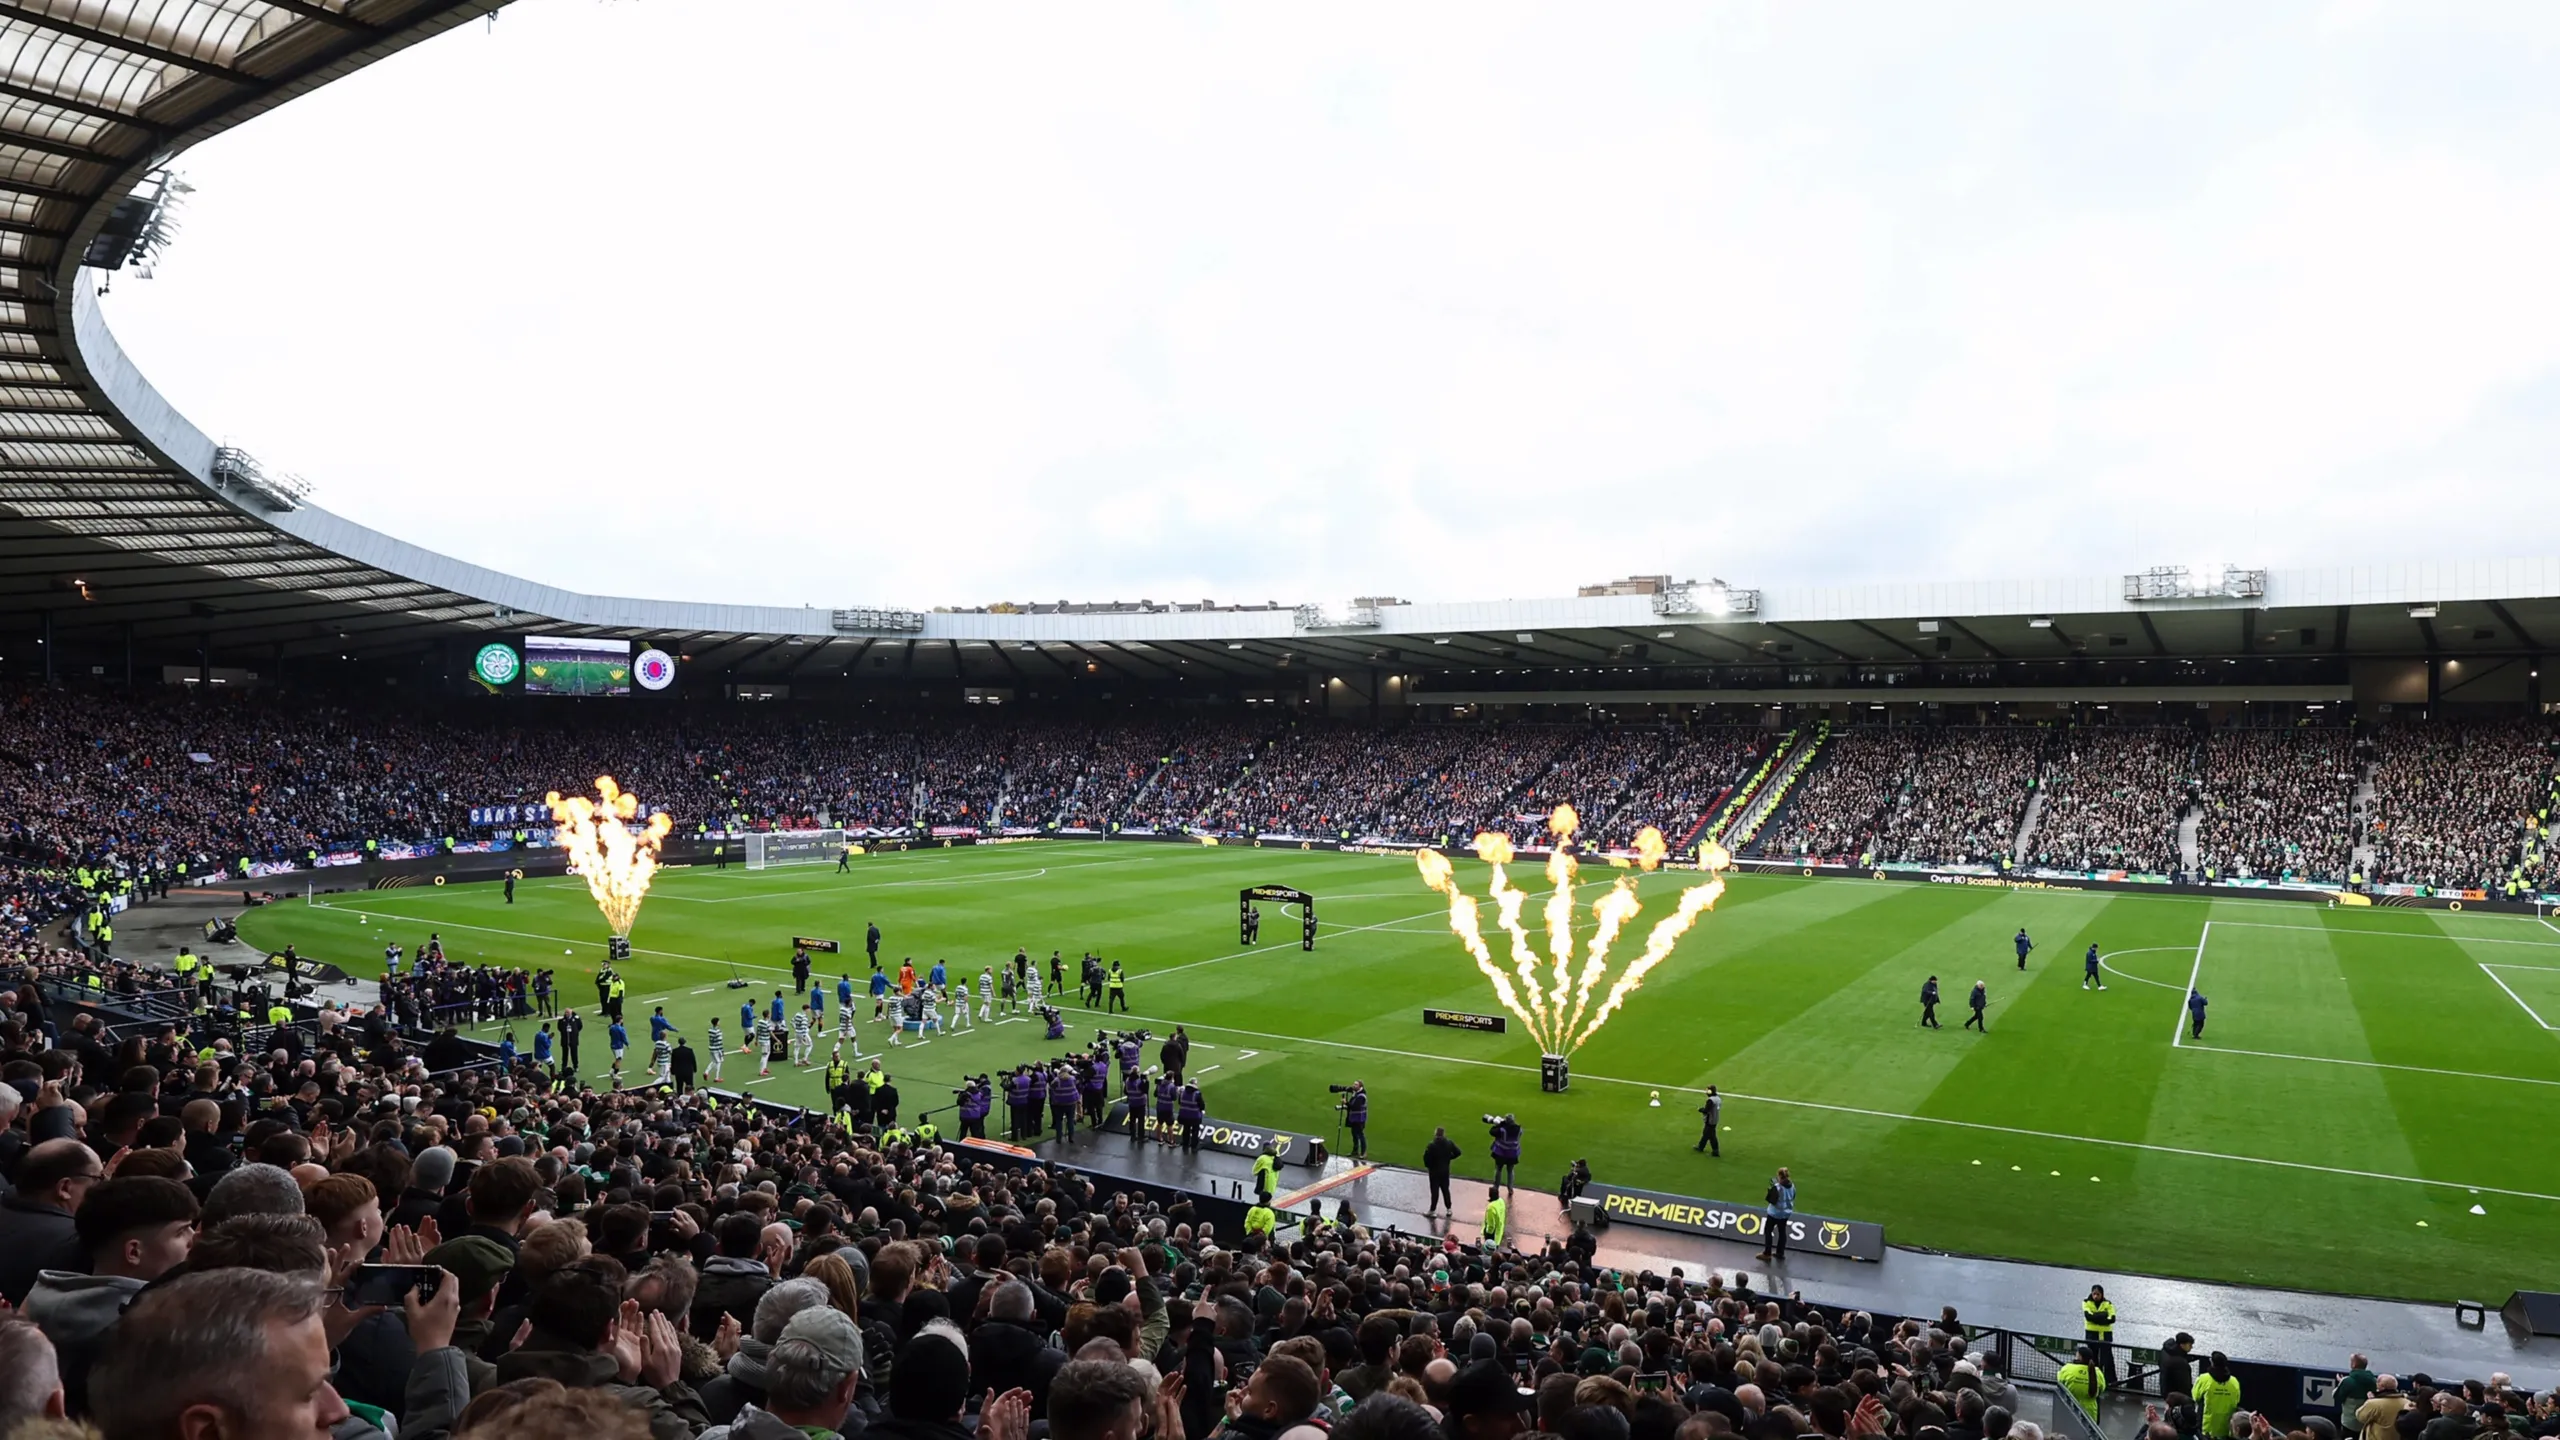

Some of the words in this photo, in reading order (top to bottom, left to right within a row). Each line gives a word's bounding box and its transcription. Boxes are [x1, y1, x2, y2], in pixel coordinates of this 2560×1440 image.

[1930, 874, 1953, 884] Over
[1953, 875, 1966, 885] 80
[1966, 877, 2005, 888] Scottish
[1435, 1012, 1493, 1026] PREMIERSPORTS
